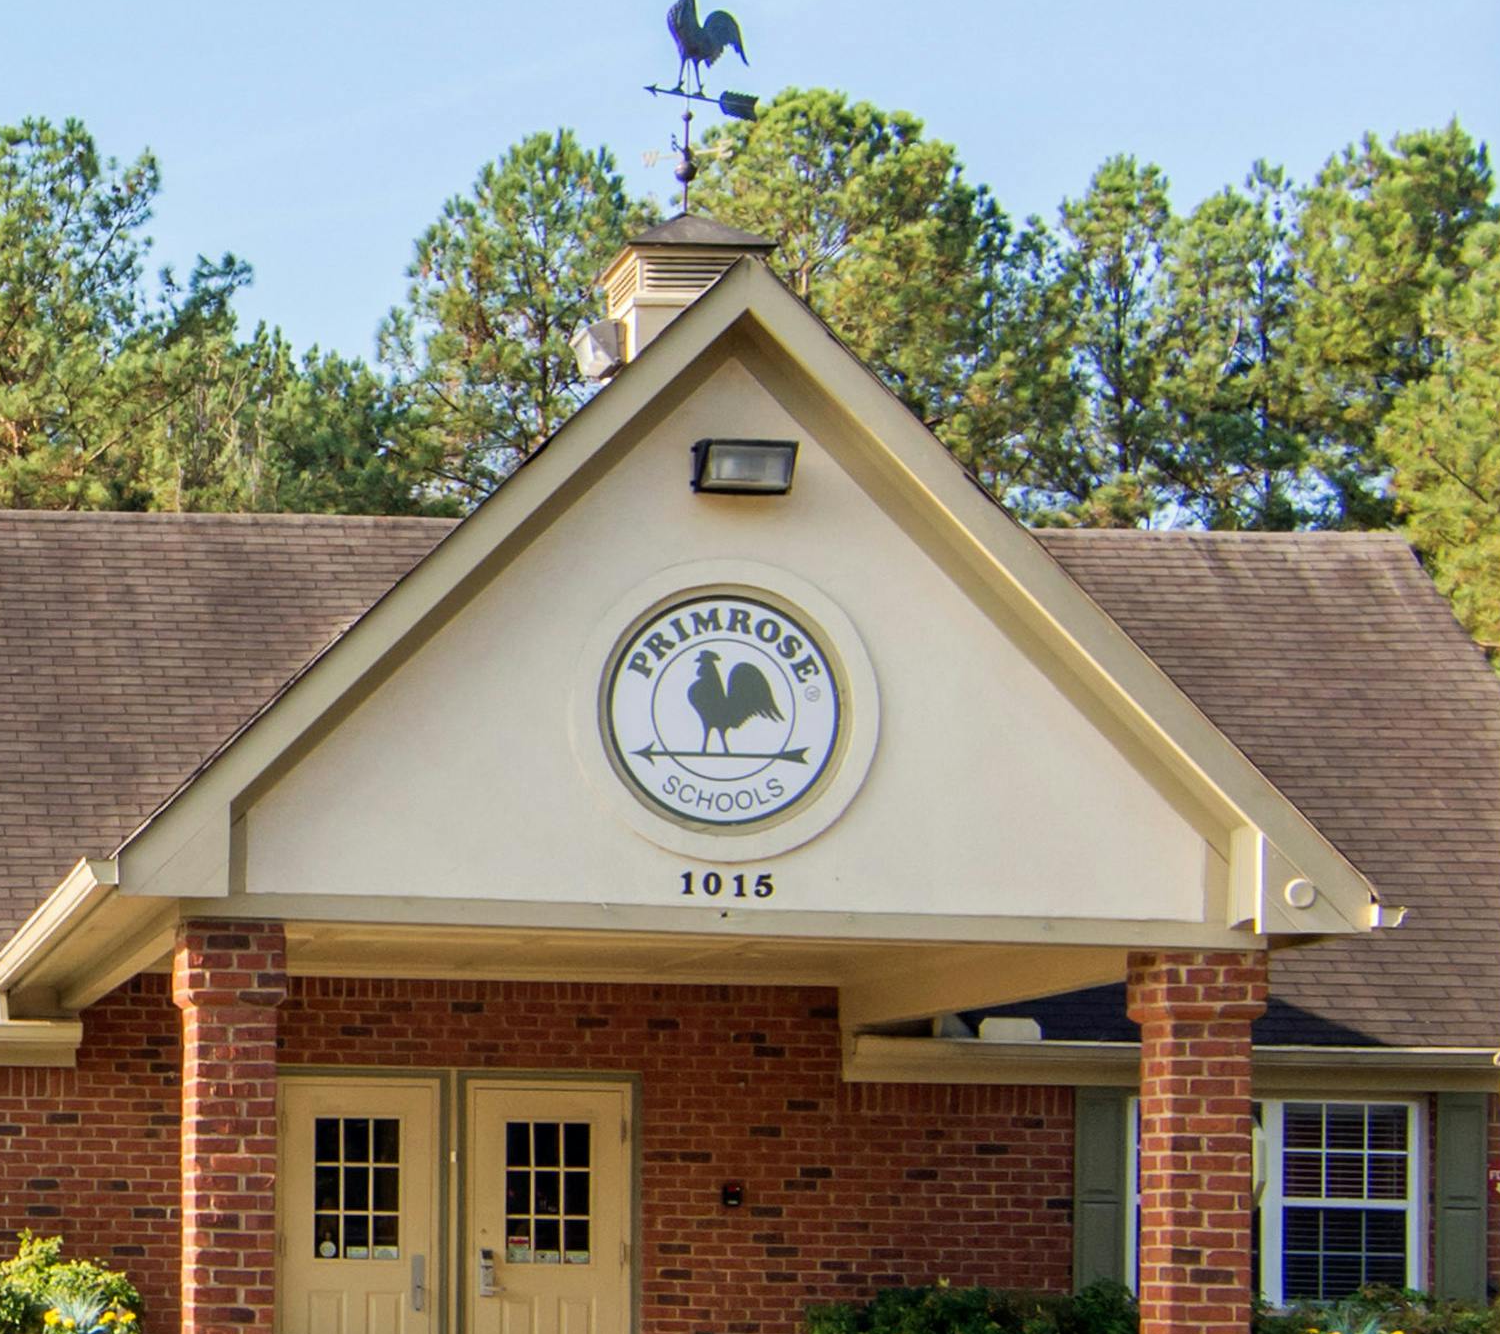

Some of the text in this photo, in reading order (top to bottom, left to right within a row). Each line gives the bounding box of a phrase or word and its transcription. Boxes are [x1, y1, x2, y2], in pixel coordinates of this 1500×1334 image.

[627, 607, 820, 684] PRIMROSE
[661, 774, 786, 813] SCHOOLS
[680, 870, 775, 898] 1015
